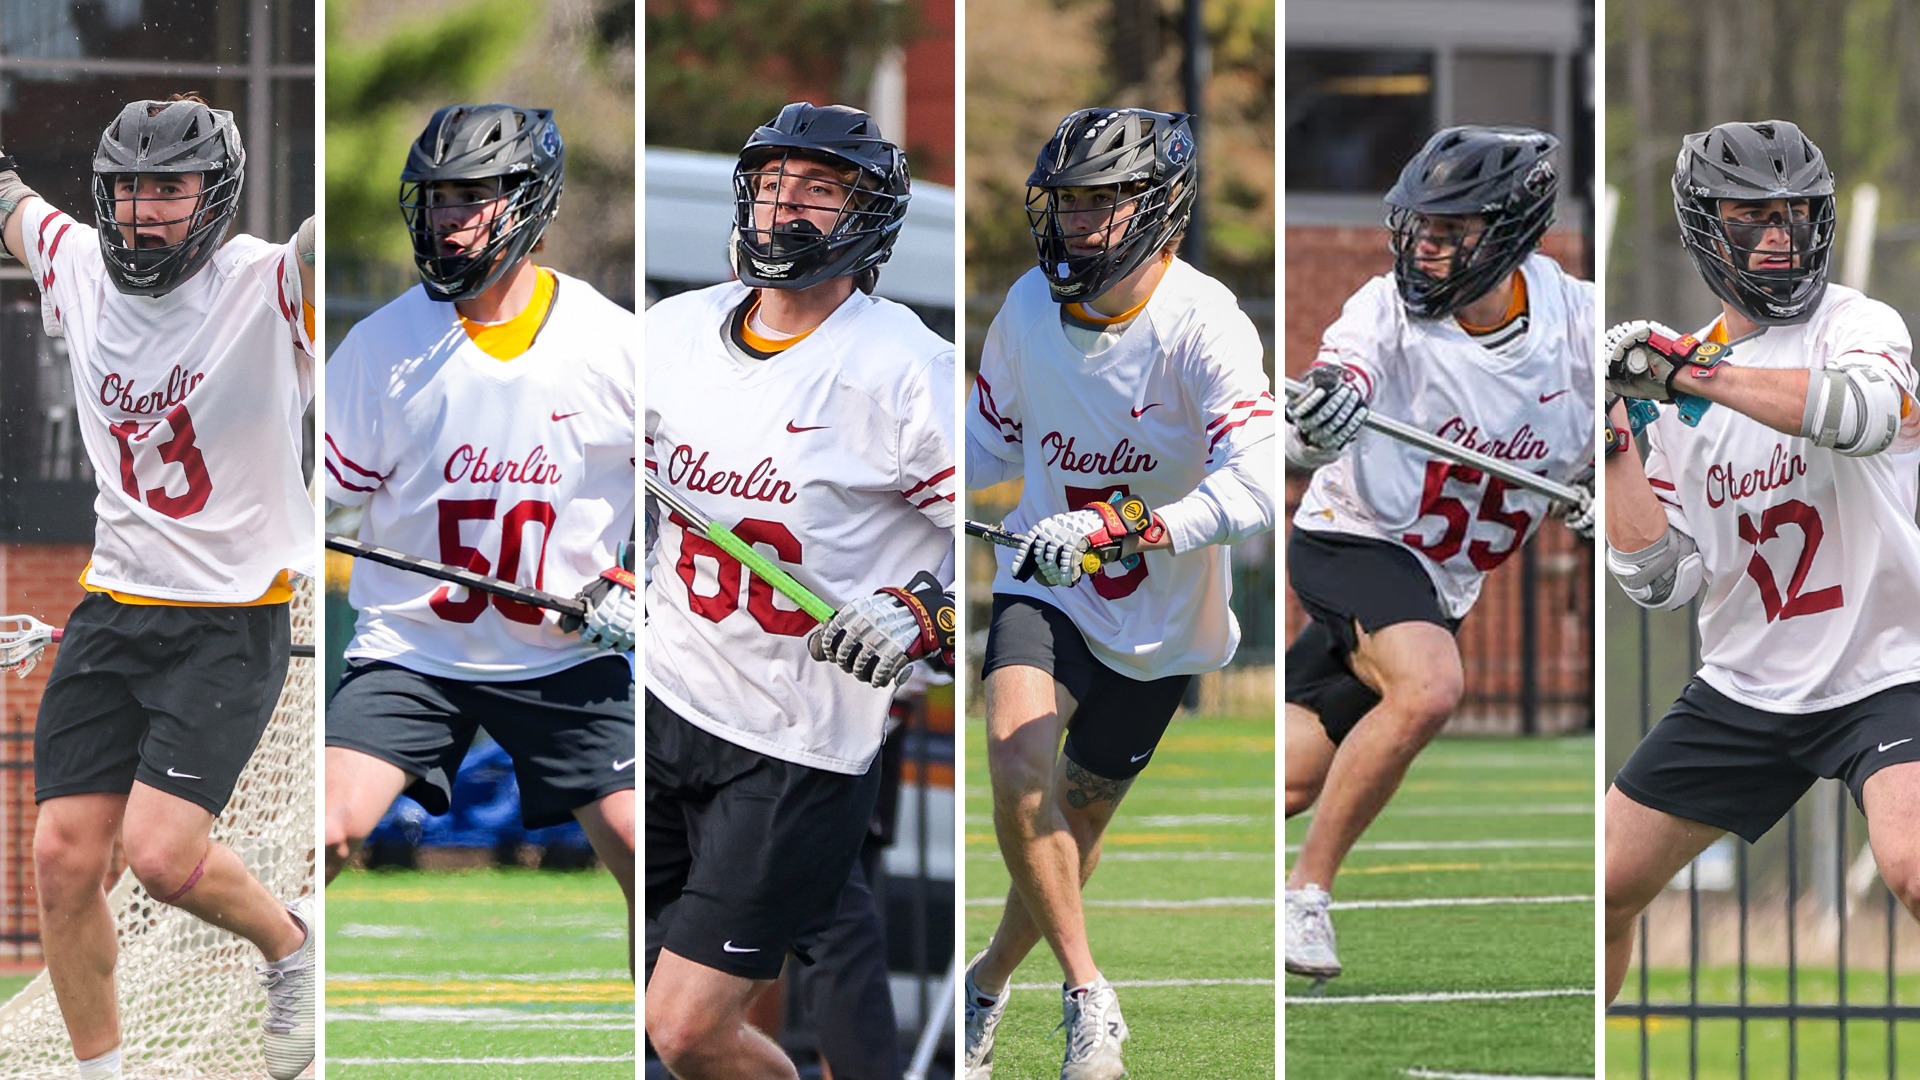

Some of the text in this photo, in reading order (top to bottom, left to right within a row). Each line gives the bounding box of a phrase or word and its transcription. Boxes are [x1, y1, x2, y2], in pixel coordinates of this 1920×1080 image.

[109, 403, 213, 520] 13
[443, 443, 563, 485] Oberlin
[668, 444, 798, 504] Oberlin
[1041, 430, 1158, 475] Oberlin
[1706, 442, 1807, 509] Oberlin
[428, 498, 557, 626] 50
[1402, 460, 1548, 572] 55
[1738, 498, 1844, 624] 12
[668, 510, 821, 638] 66
